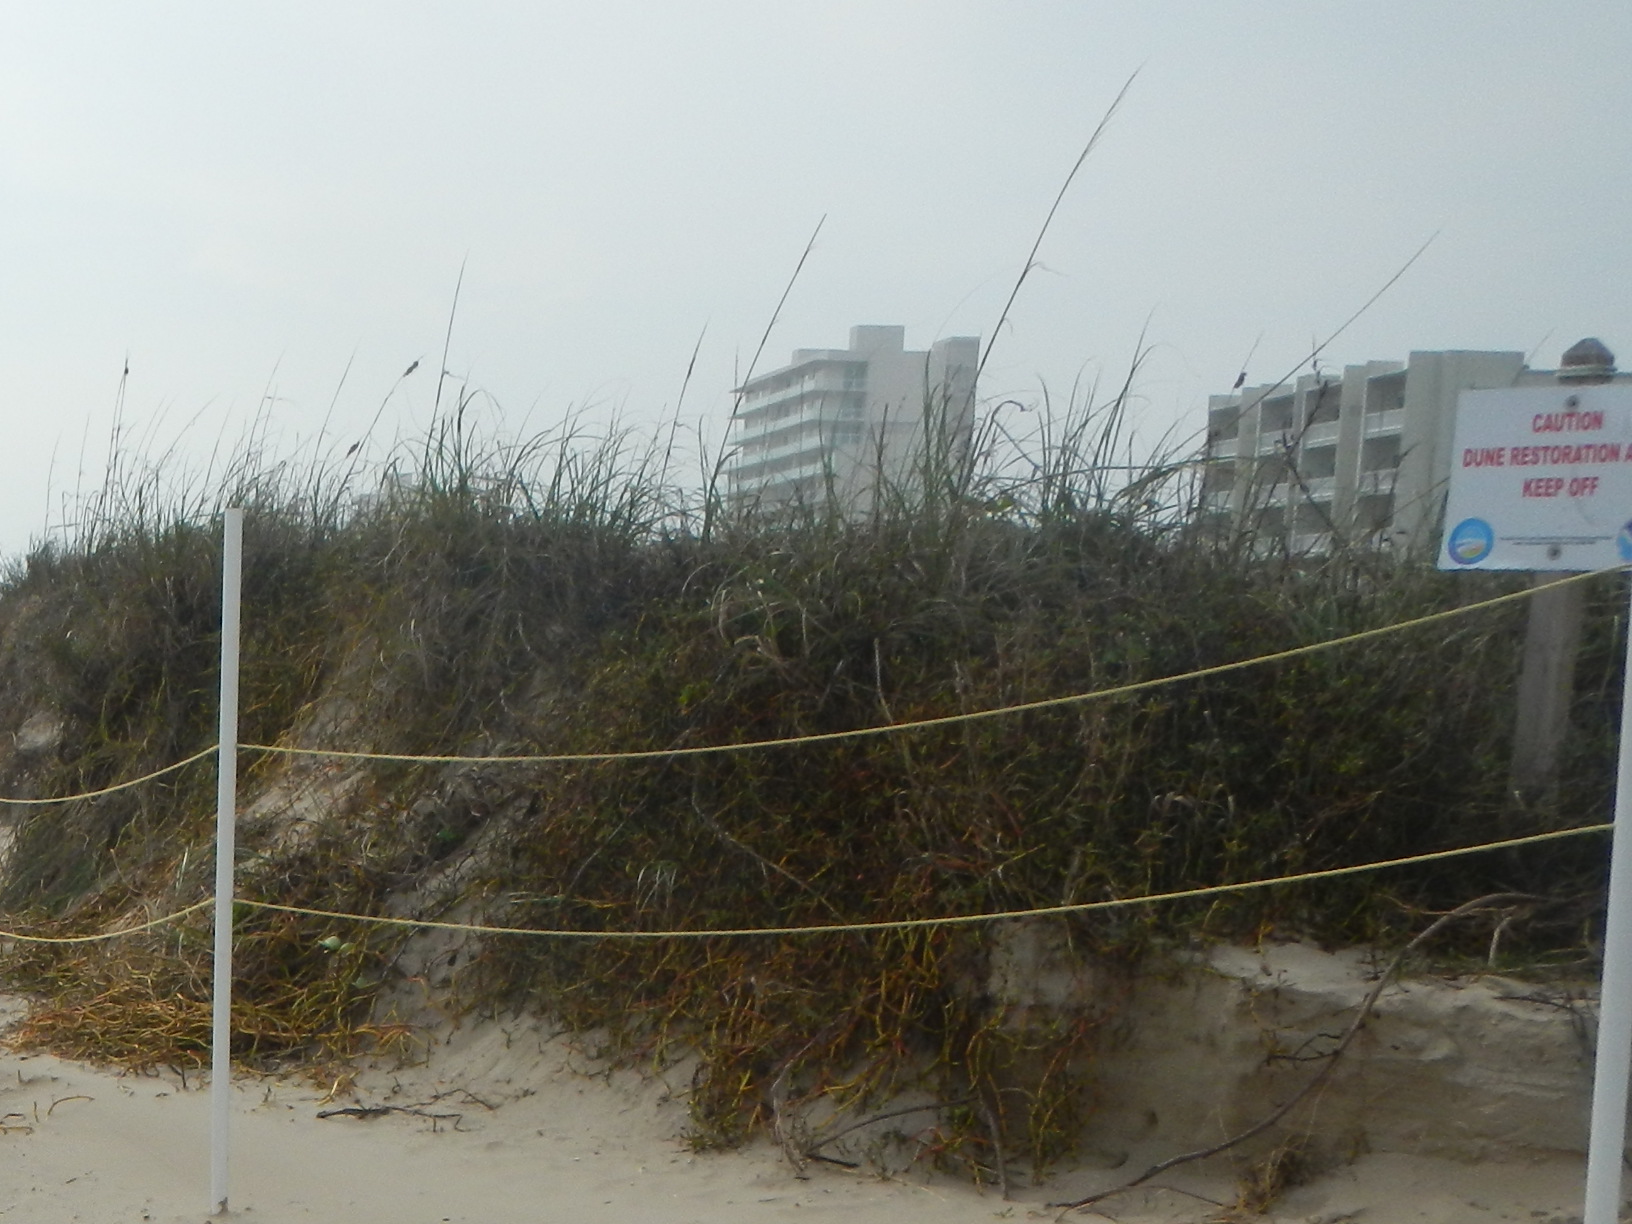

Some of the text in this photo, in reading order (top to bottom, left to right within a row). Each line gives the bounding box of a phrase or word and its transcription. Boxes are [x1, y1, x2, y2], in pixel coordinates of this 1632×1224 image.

[1532, 411, 1603, 432] CAUTION
[1462, 448, 1505, 467] DUNE
[1510, 444, 1621, 466] RESTORATION
[1522, 476, 1599, 497] KEEP OFF
